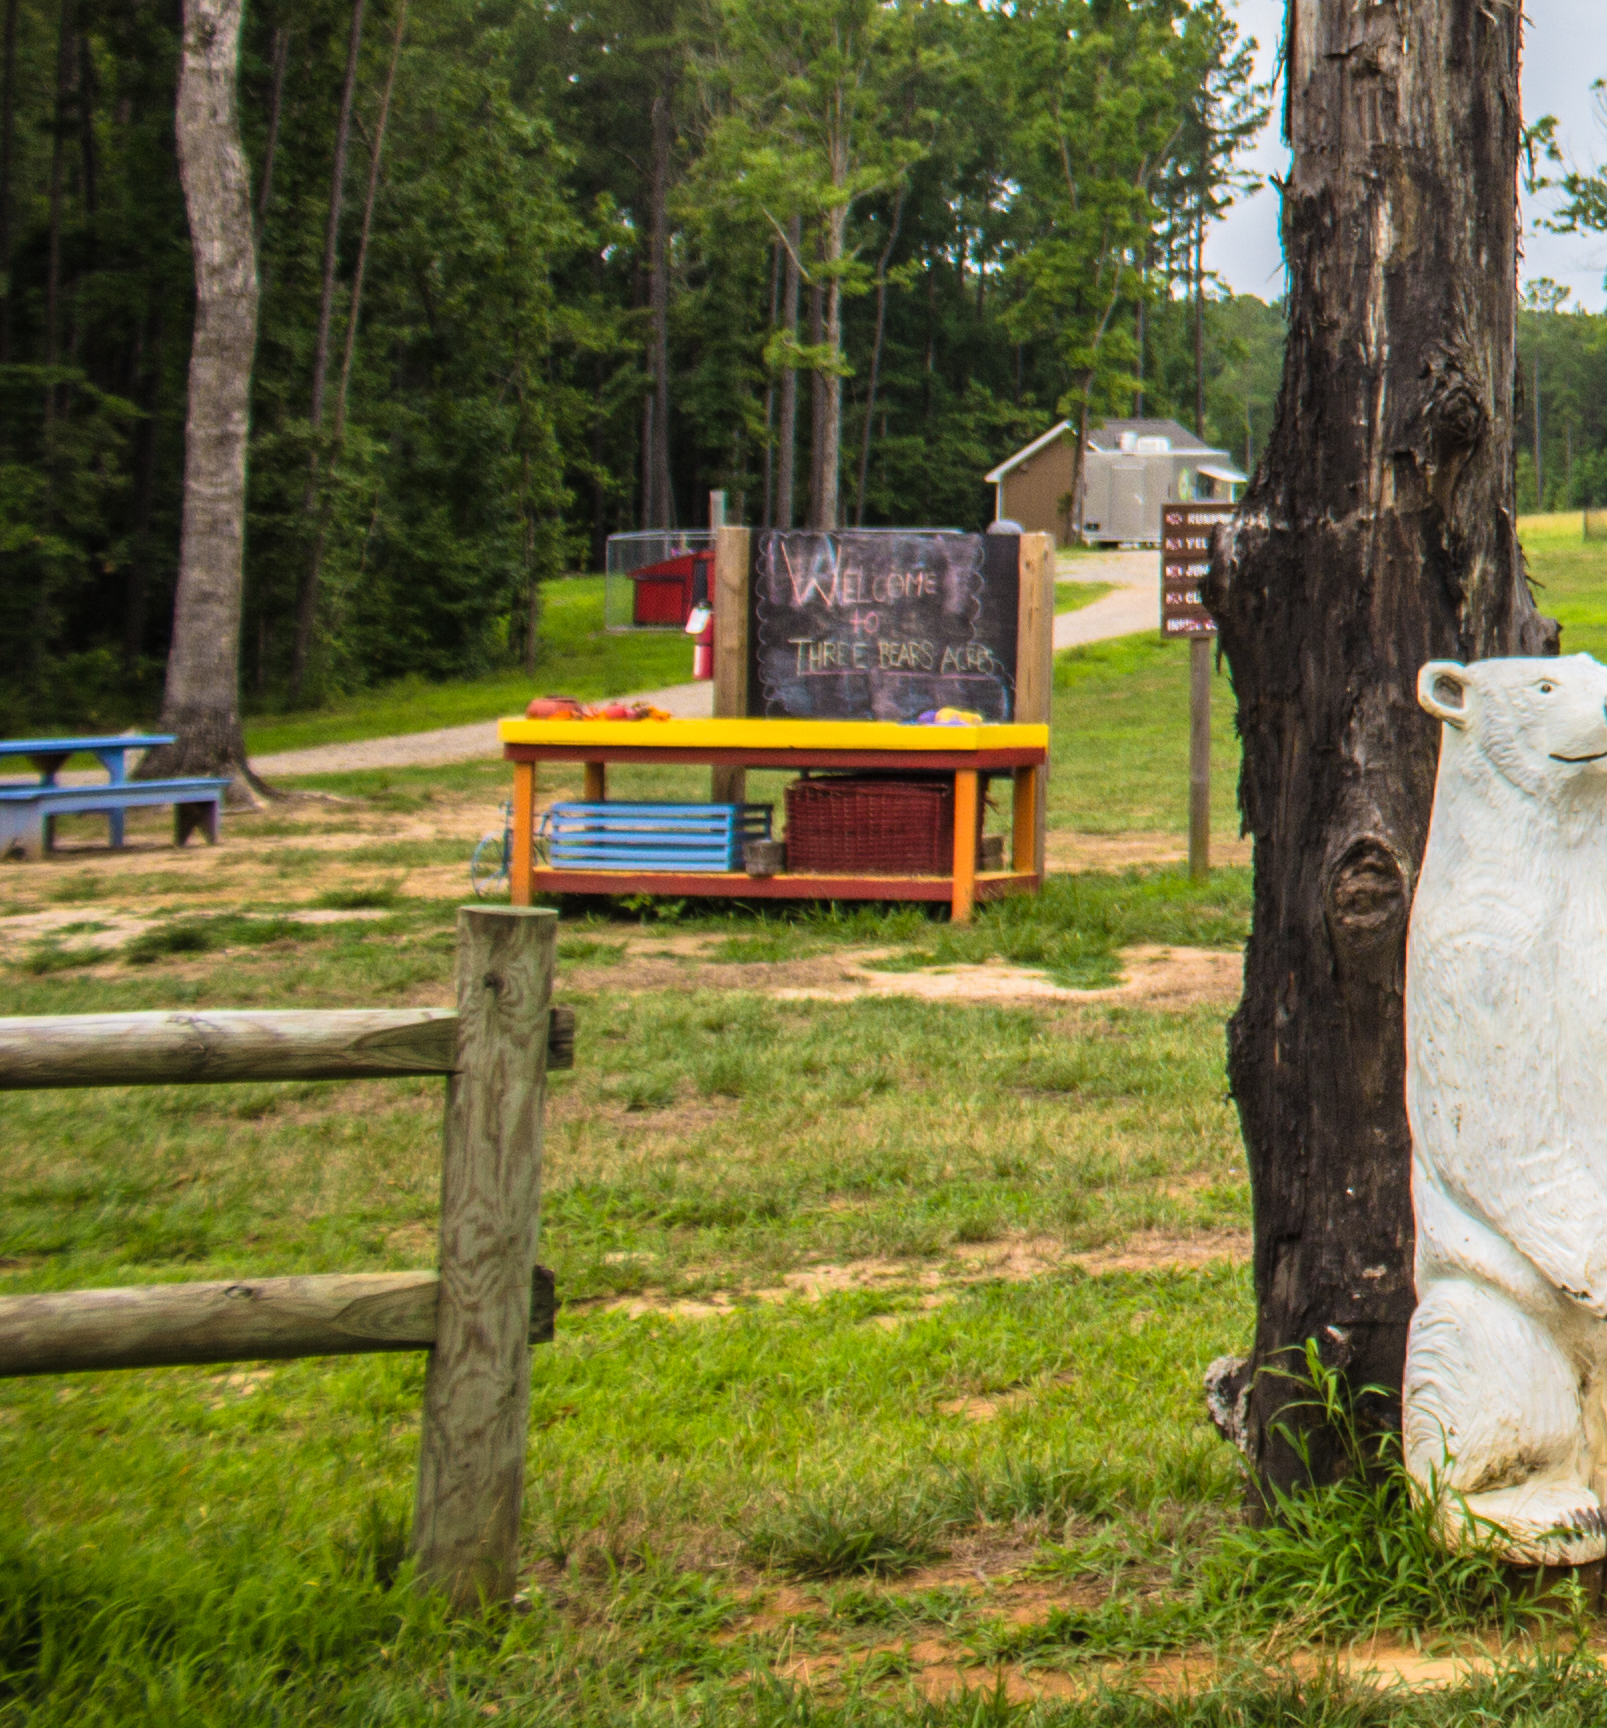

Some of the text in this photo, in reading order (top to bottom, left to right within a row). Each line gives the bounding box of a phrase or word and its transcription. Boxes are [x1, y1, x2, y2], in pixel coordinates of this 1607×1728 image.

[781, 540, 937, 607] WELCOME
[850, 609, 880, 635] to
[788, 638, 868, 676] THREE
[878, 640, 935, 671] BEARS
